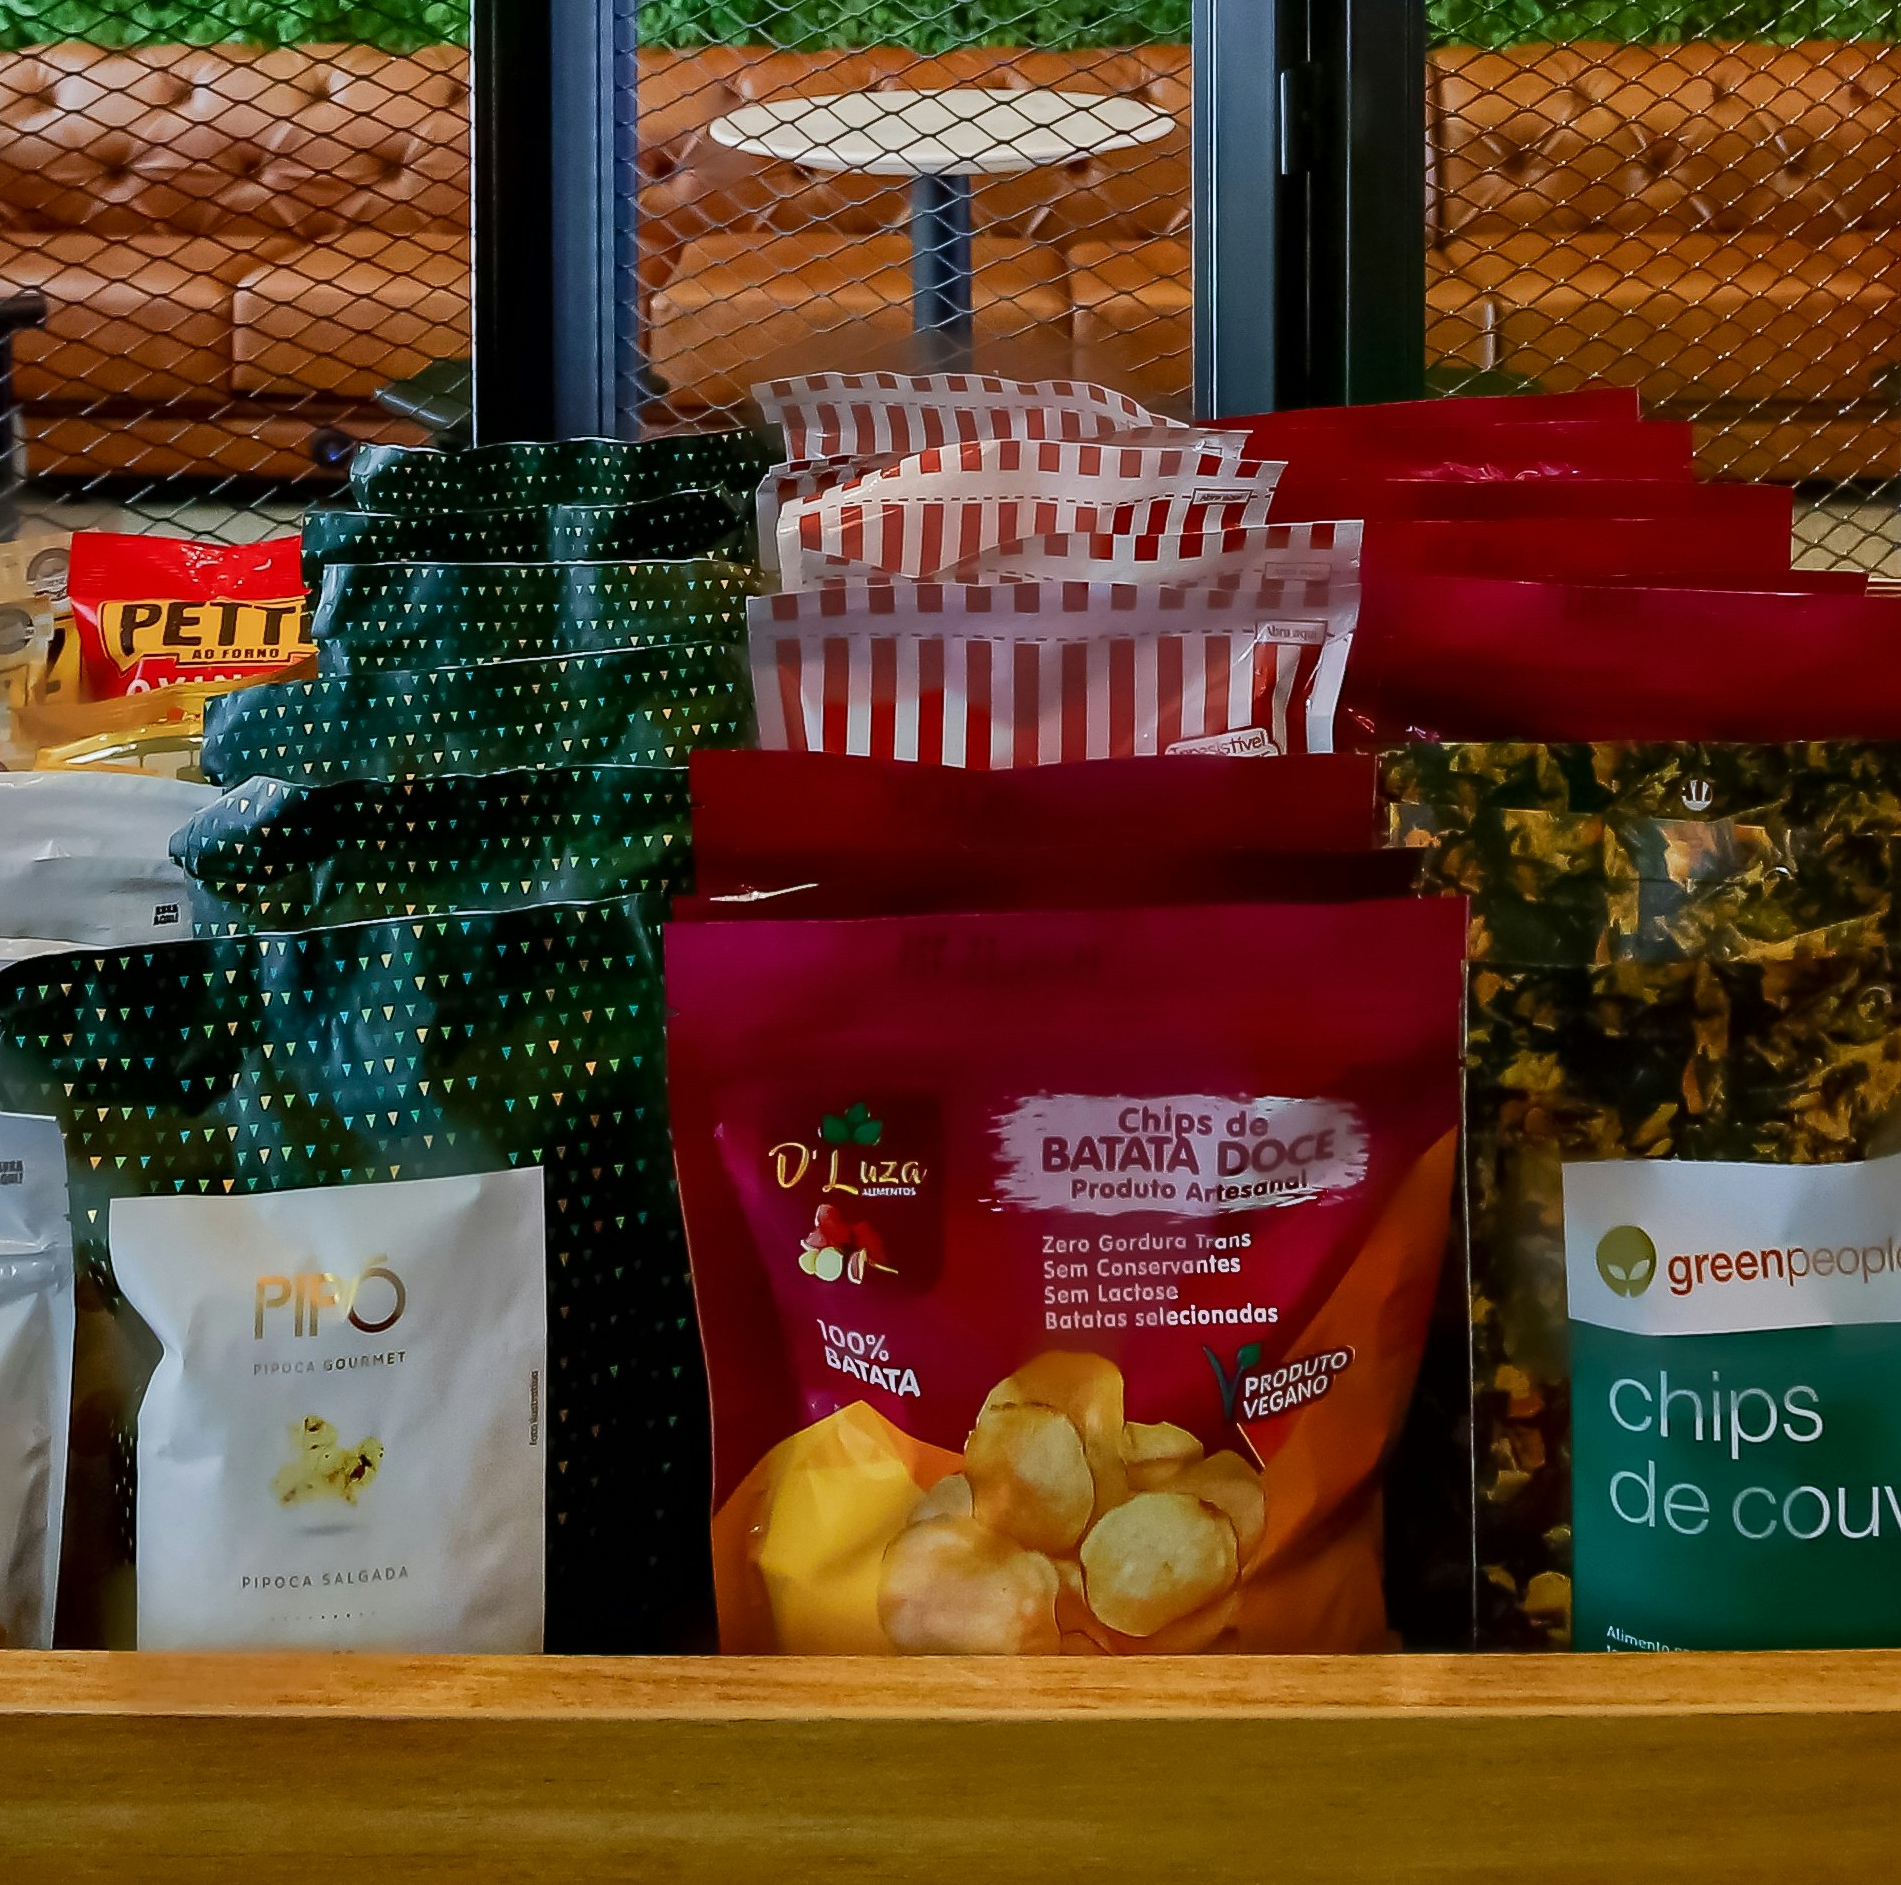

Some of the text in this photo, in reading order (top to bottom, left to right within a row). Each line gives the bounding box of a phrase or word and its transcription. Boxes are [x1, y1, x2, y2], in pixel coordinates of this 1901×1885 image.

[220, 647, 281, 660] FORNO
[1117, 1103, 1270, 1139] Chips de
[1041, 1128, 1337, 1178] BATATA DOCE
[1070, 1169, 1309, 1203] Produto Artesanal
[1041, 1231, 1252, 1254] Zero Gordura Trans
[1043, 1253, 1241, 1280] Sem Conservantes
[1044, 1282, 1179, 1305] Sem Lactose
[1045, 1302, 1279, 1330] Batatas selecionadas
[816, 1317, 892, 1364] 100%
[253, 1350, 407, 1376] PIPOCA GOURMET
[823, 1345, 923, 1399] BATATA
[1243, 1349, 1350, 1398] PRODUTO
[1241, 1373, 1331, 1421] VEGANO
[1608, 1370, 1825, 1461] chips
[1608, 1459, 1710, 1537] de
[241, 1563, 410, 1591] PIPOCA SALGADA
